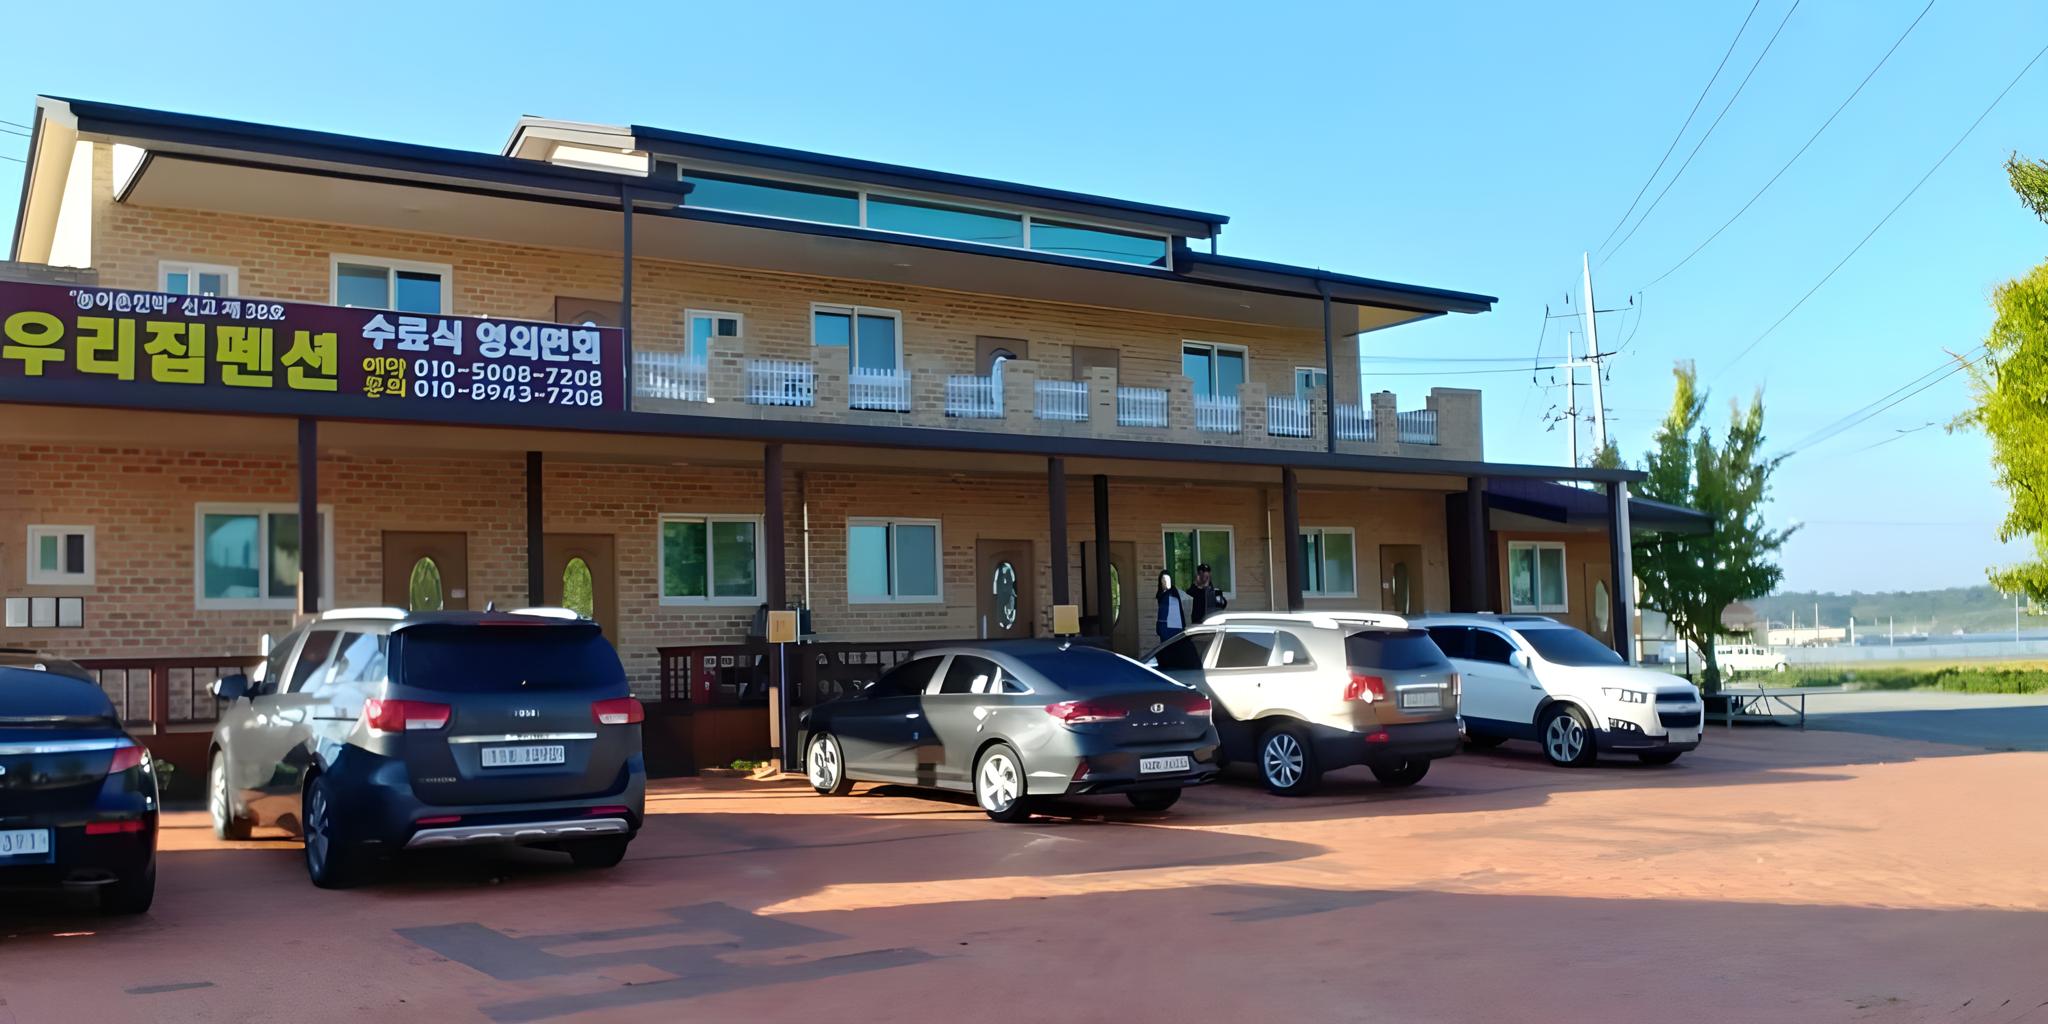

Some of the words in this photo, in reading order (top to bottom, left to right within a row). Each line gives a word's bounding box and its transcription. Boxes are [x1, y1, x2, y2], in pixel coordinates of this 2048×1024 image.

[3, 310, 338, 392] 우리집펜션
[362, 314, 462, 355] 수료식
[476, 322, 600, 364] 영외면회
[414, 359, 602, 387] 010-5008-7208
[414, 380, 603, 407] 010-8943-7208
